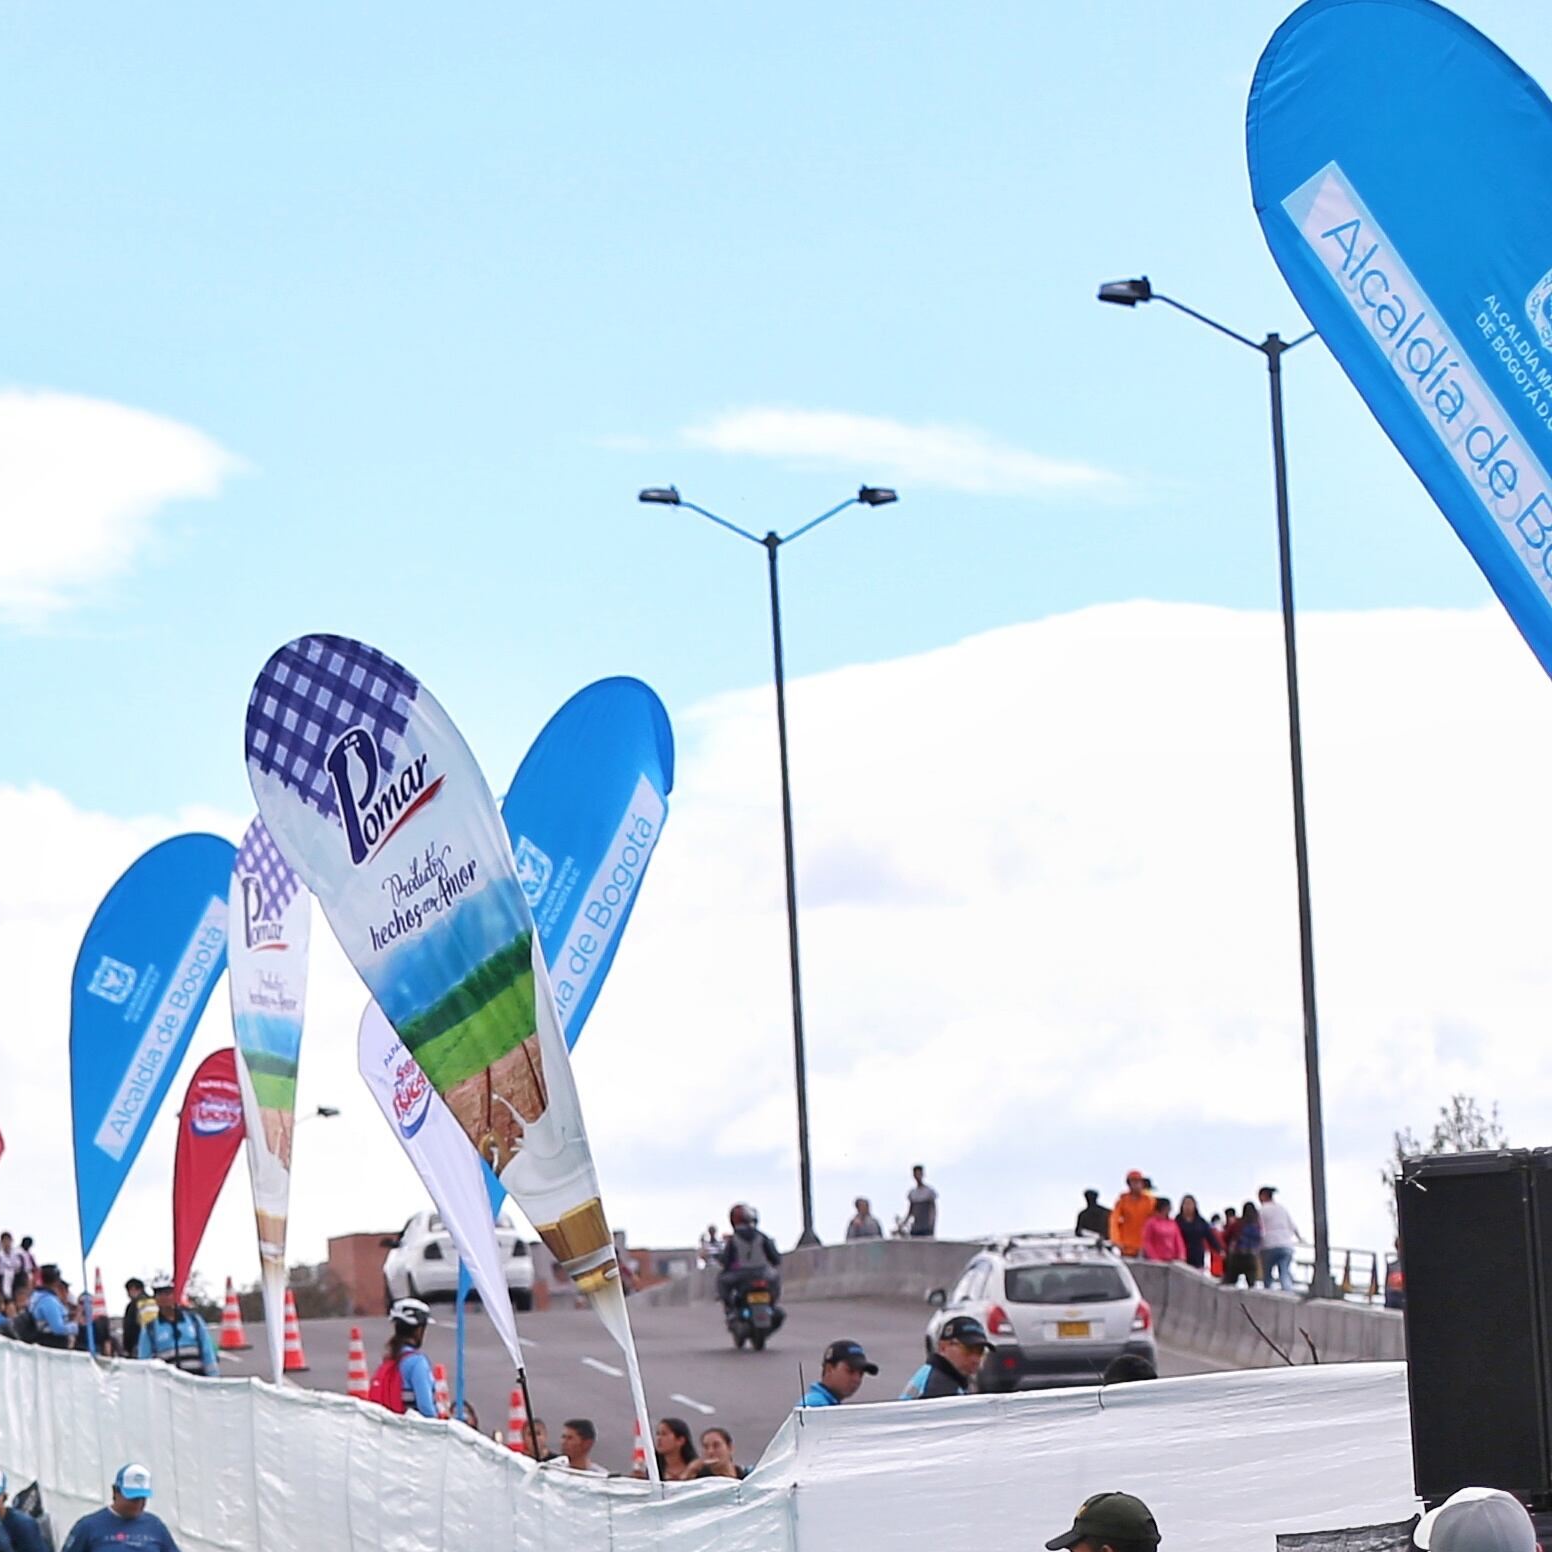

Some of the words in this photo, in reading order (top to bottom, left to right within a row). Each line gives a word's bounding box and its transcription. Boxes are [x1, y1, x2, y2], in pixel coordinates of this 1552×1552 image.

[1321, 219, 1464, 424] Alcaldía
[1464, 418, 1519, 500] de
[1475, 312, 1497, 339] DE
[1491, 335, 1542, 406] BOGOTÁ
[326, 728, 428, 865] Pomar
[369, 904, 423, 952] hechos
[434, 859, 478, 912] Amor
[569, 933, 598, 975] de
[584, 813, 653, 930] Bogotá
[111, 1048, 163, 1137] Alcaldía
[156, 1013, 180, 1045] de
[169, 925, 224, 1010] Bogotá
